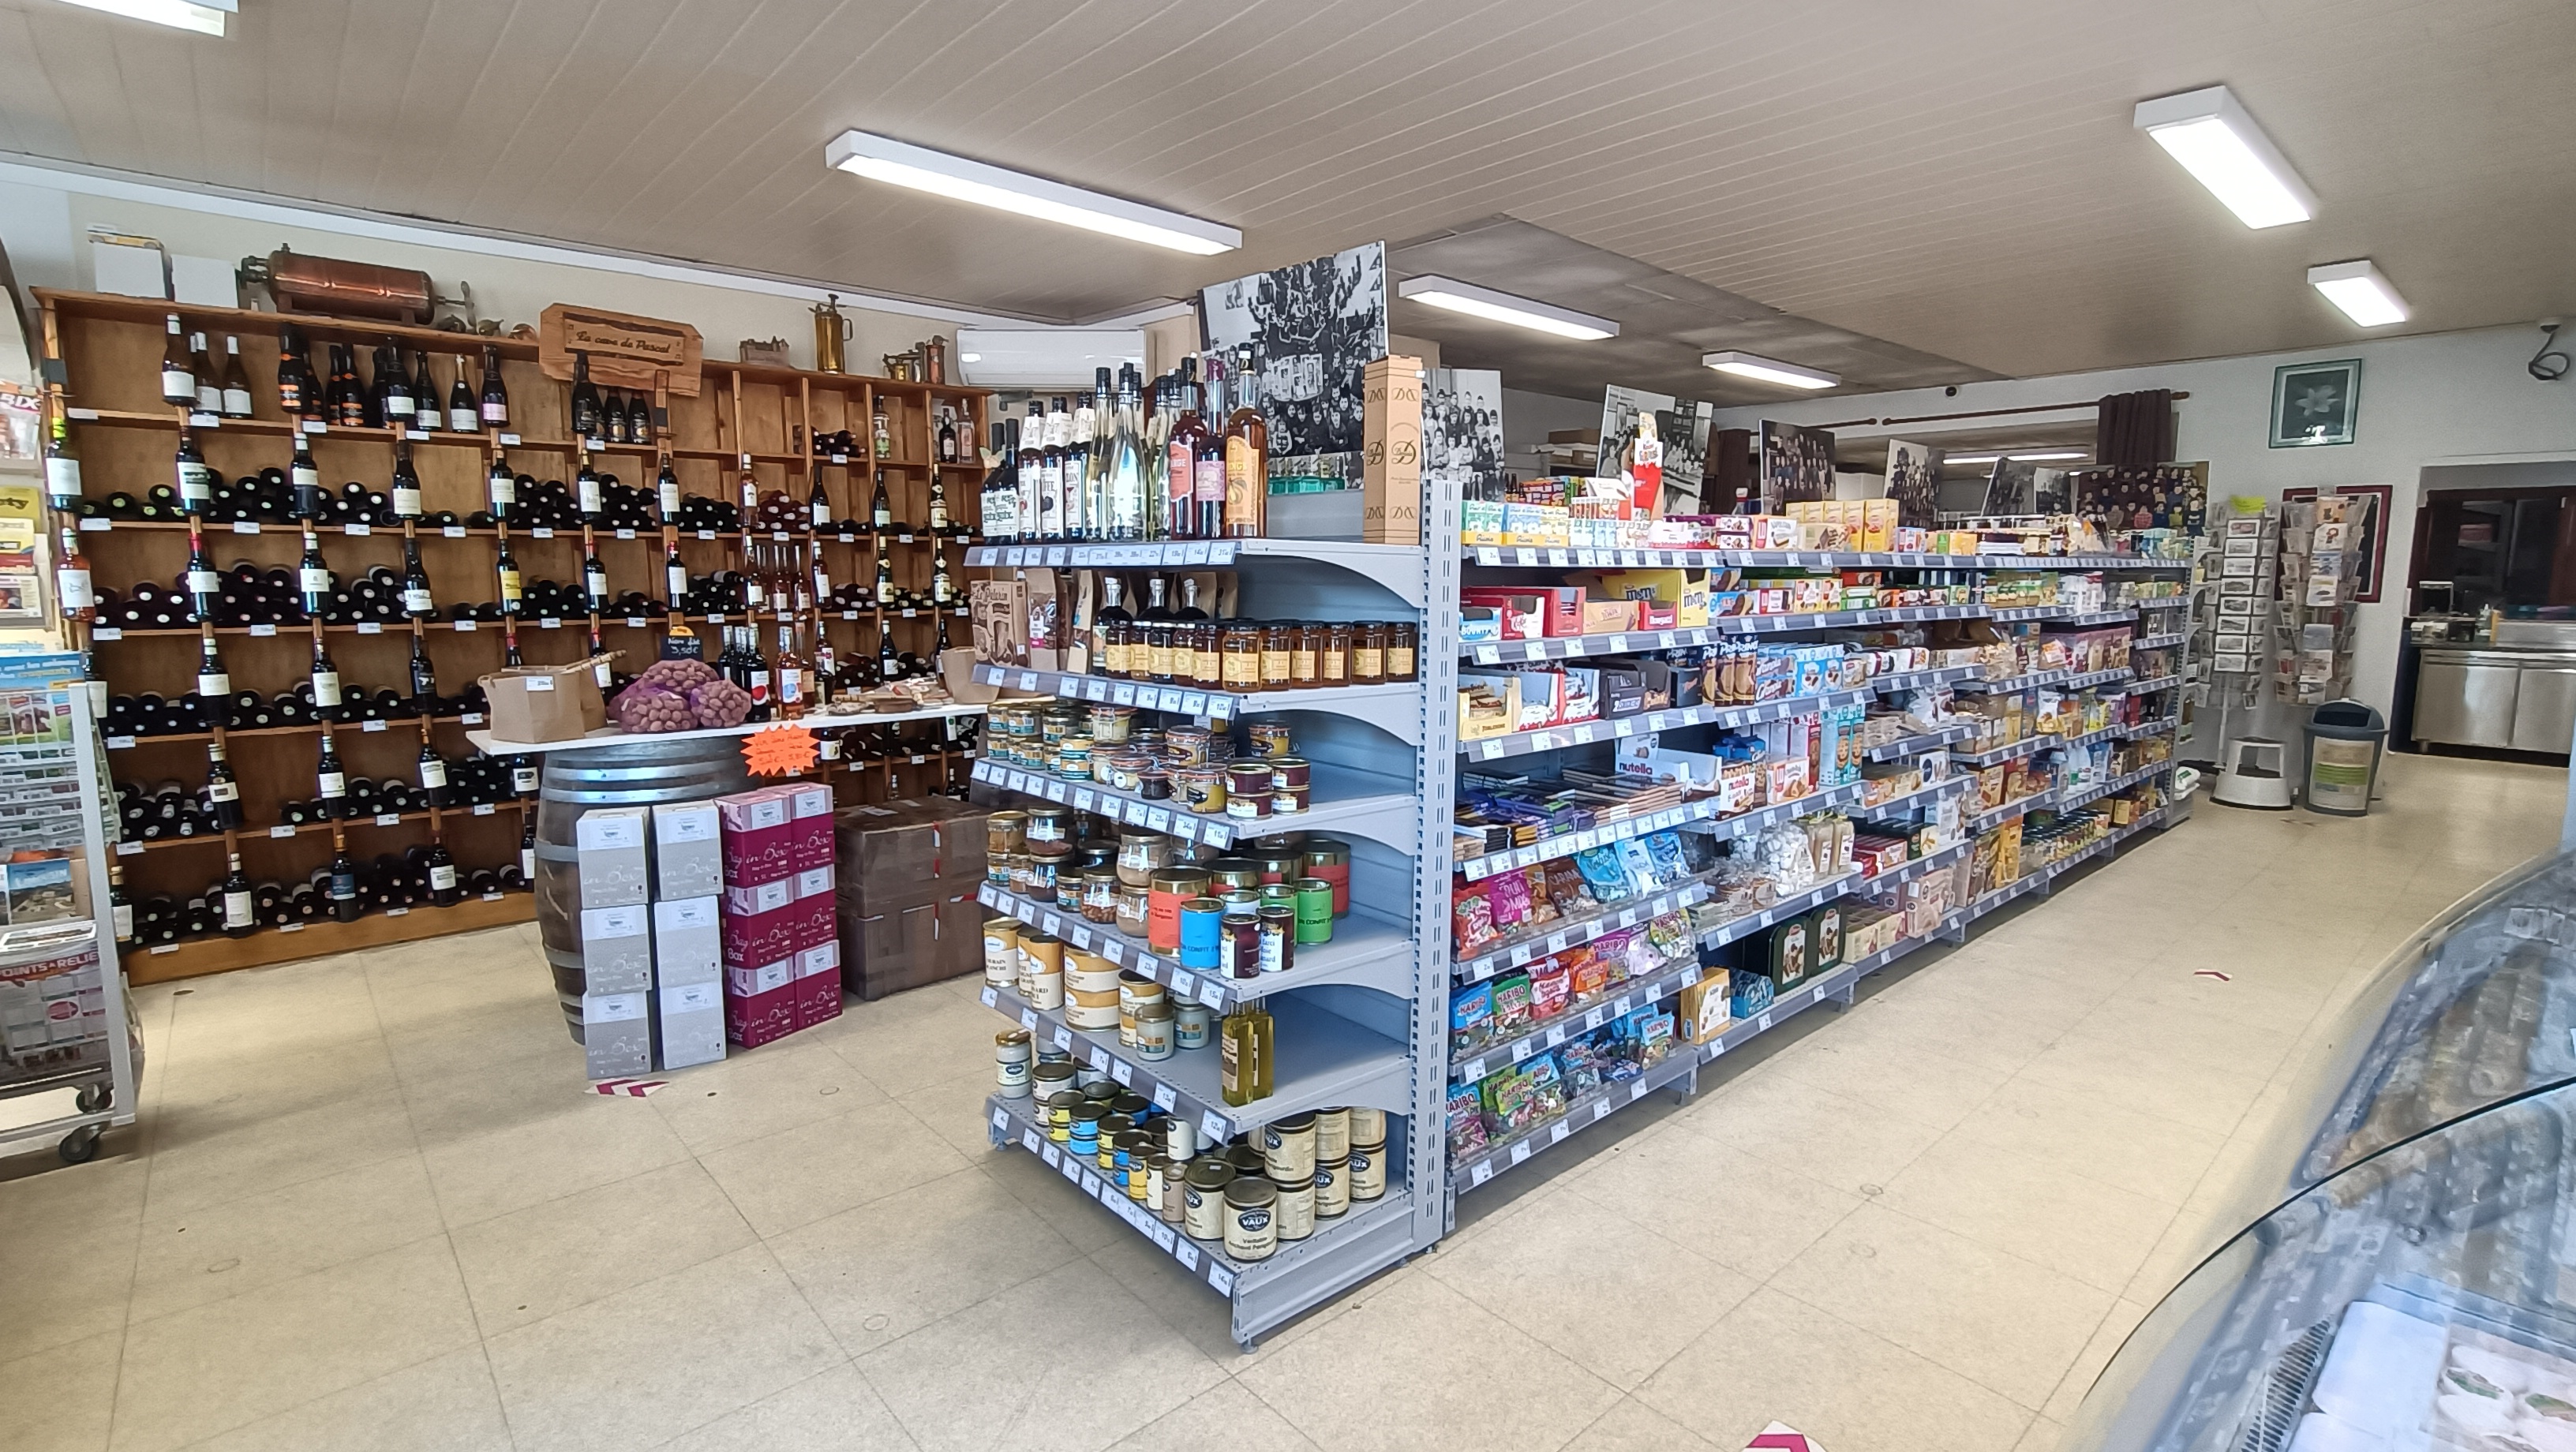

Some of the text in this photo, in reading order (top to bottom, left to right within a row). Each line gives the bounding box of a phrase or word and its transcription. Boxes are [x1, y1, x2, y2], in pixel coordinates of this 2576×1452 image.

[635, 340, 670, 353] Pascal
[1619, 762, 1653, 775] nutella
[1593, 938, 1627, 952] HARIBO
[728, 948, 744, 962] Box
[0, 962, 48, 978] OINTS
[57, 951, 99, 968] RELIE
[1496, 985, 1526, 1002] HARIBO
[1242, 1216, 1268, 1226] VAUX
